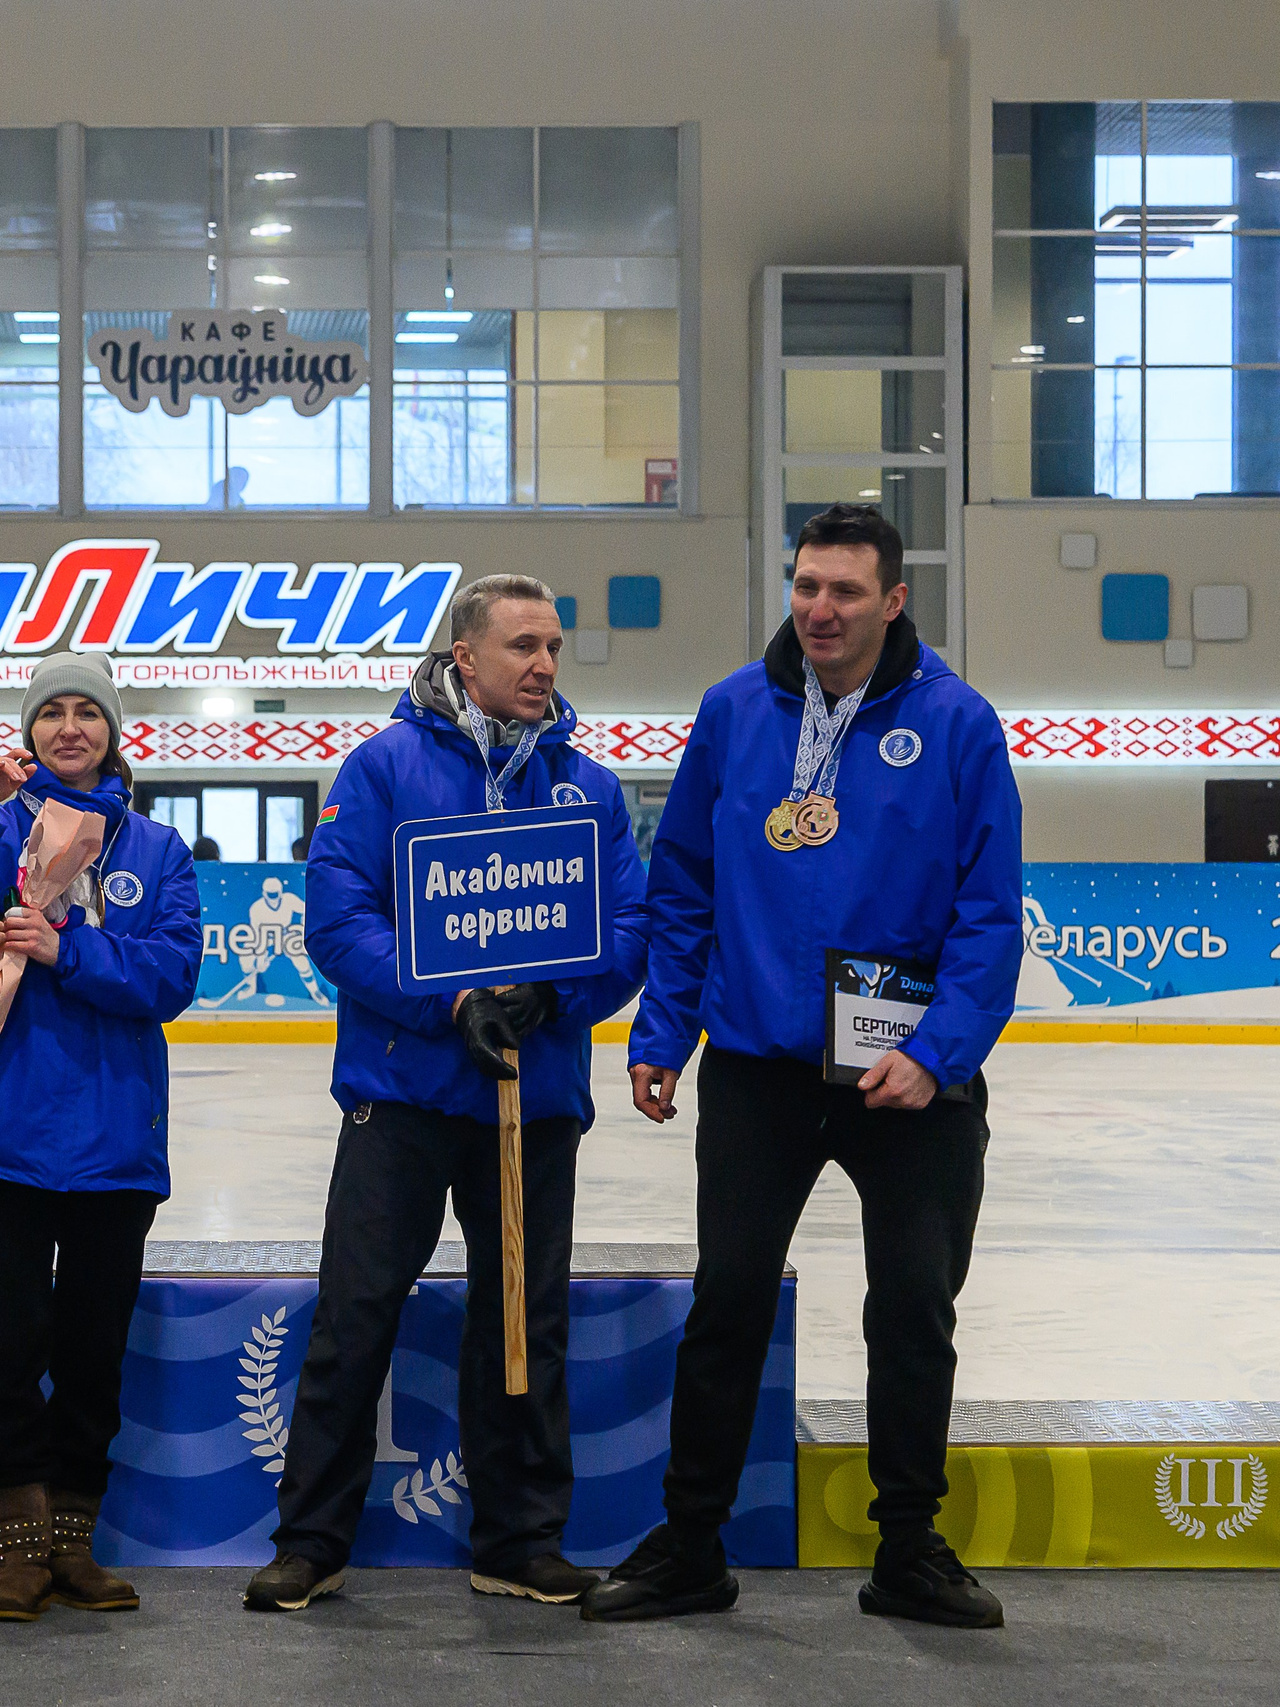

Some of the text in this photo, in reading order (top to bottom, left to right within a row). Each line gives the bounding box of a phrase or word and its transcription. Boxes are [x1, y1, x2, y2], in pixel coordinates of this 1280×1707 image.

[181, 321, 276, 342] КАФЕ
[100, 340, 357, 406] Чараўніца
[117, 659, 358, 681] ГОРНОЛЫЖНЫЙ
[368, 664, 414, 683] ЦЕ
[425, 852, 584, 901] Академия
[445, 902, 568, 949] сервиса
[1023, 914, 1228, 970] еларусь
[853, 1015, 914, 1038] СЕРТИФ
[1173, 1458, 1249, 1507] III
